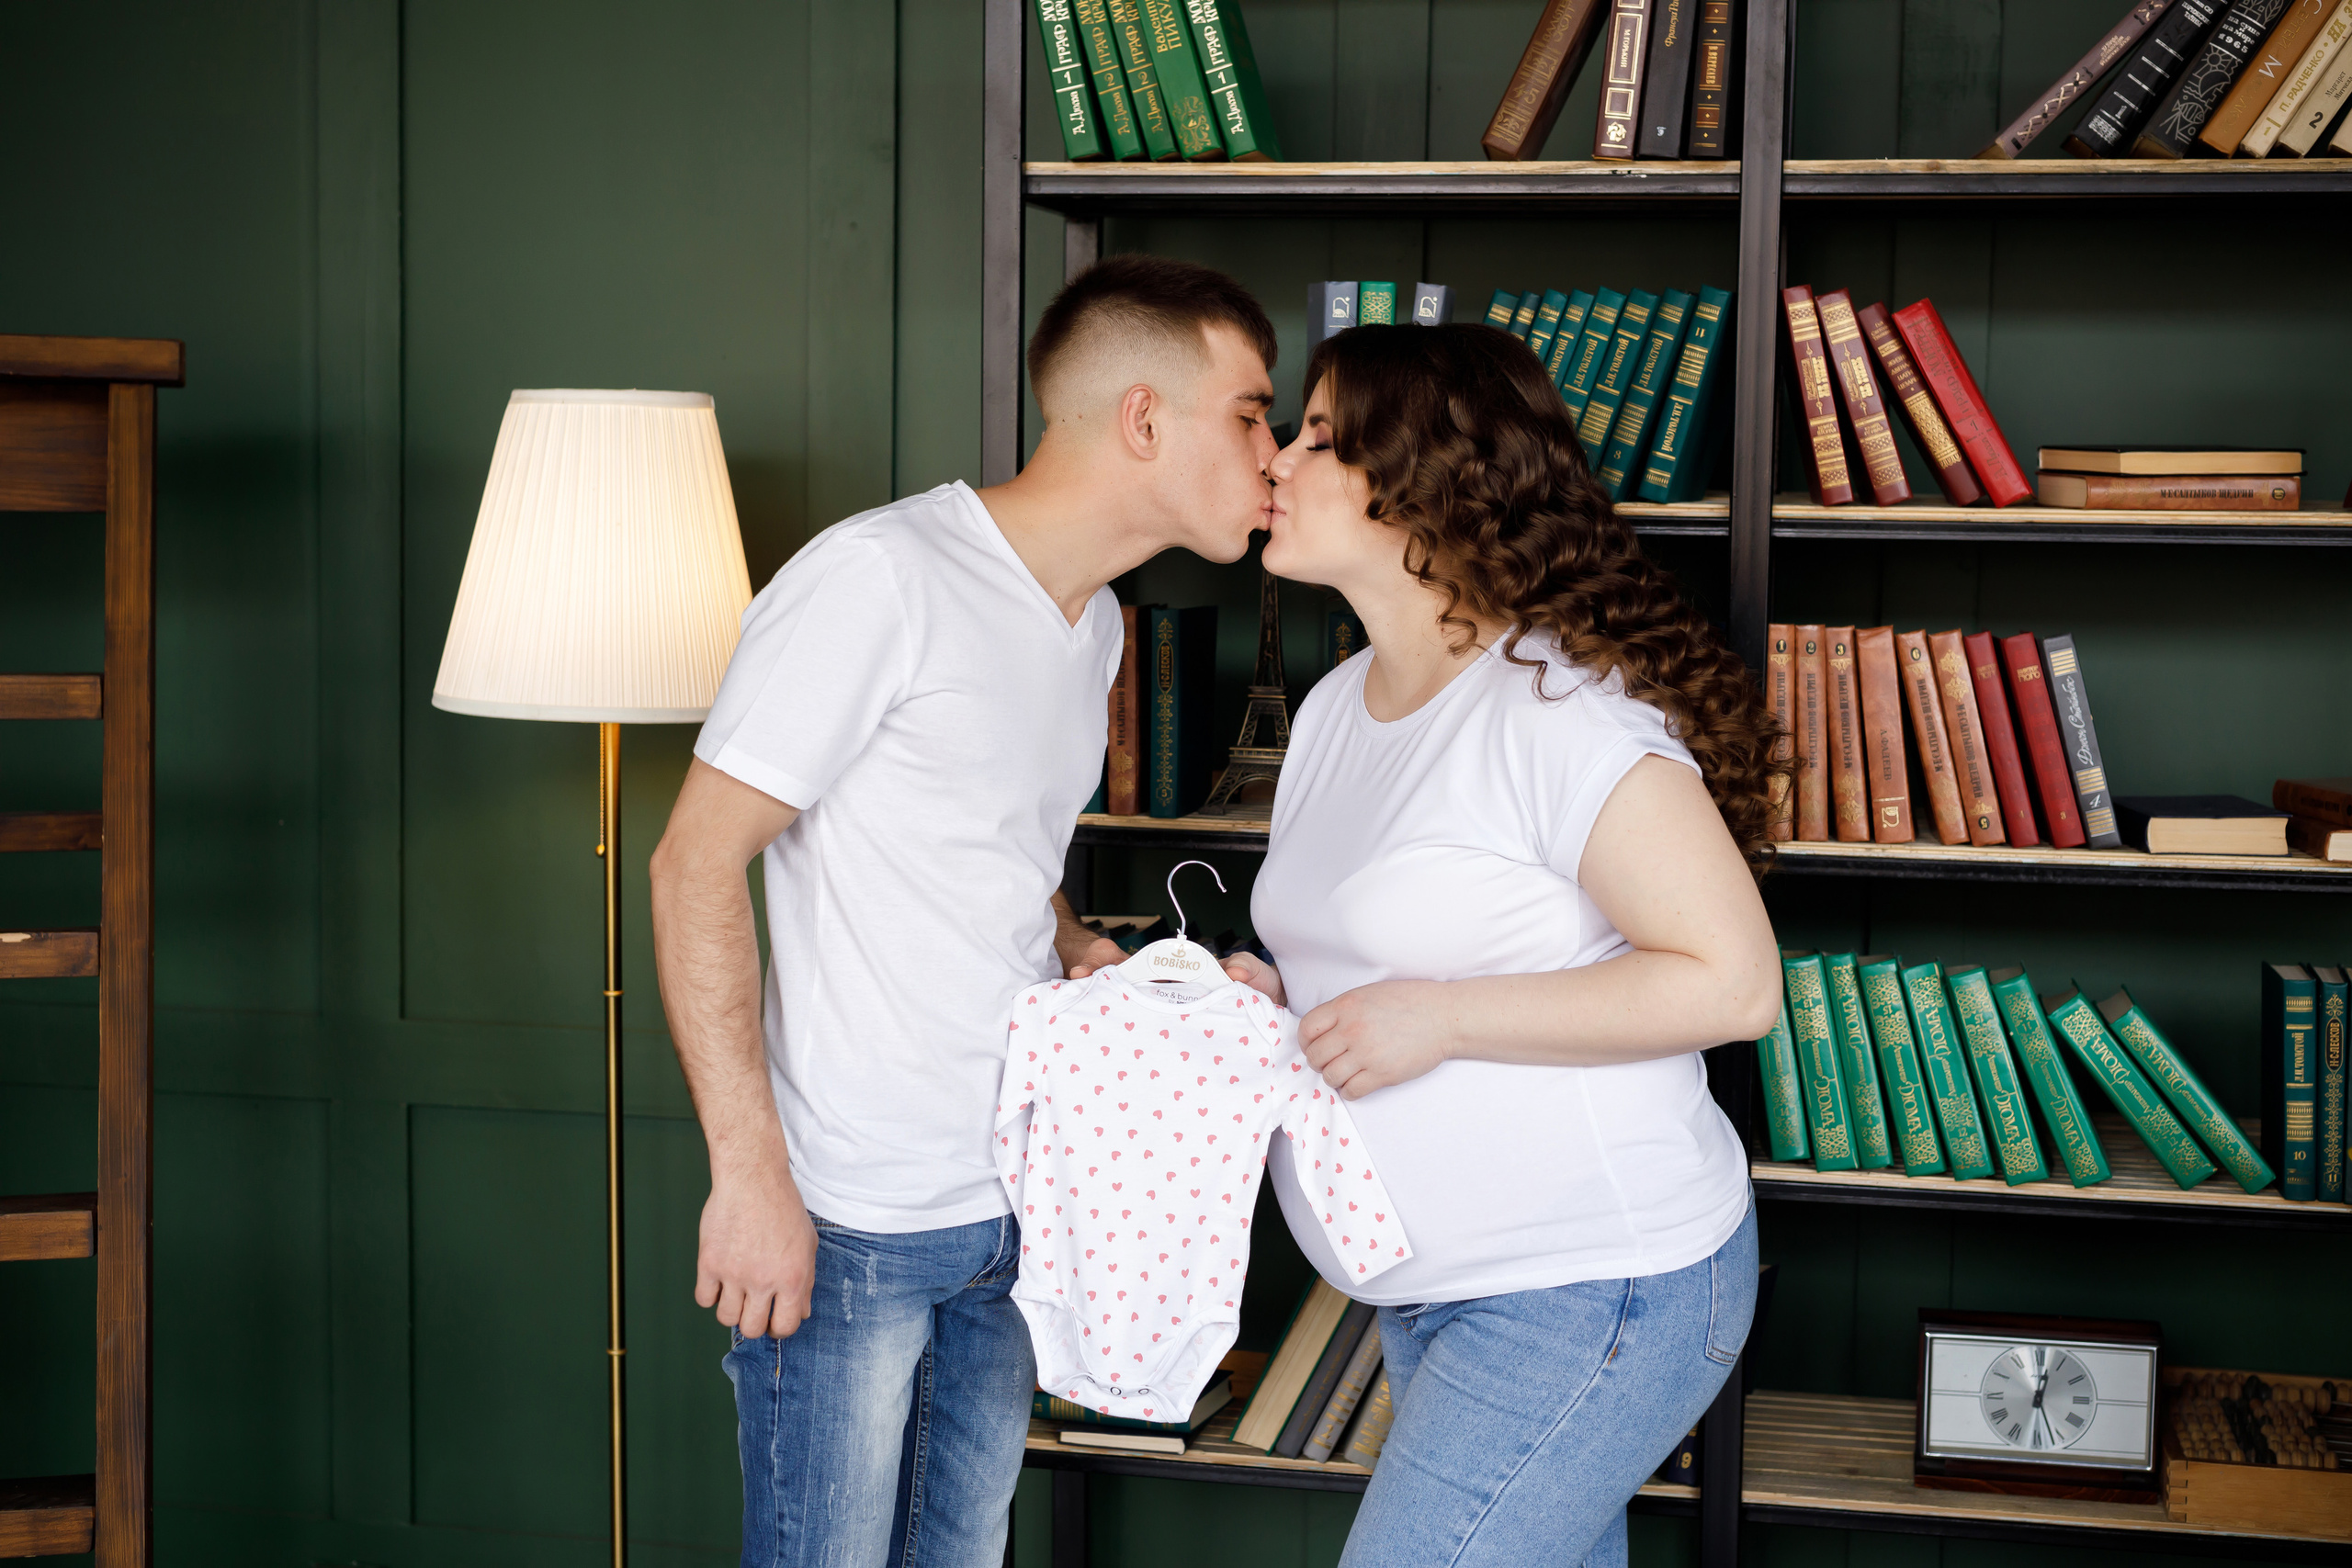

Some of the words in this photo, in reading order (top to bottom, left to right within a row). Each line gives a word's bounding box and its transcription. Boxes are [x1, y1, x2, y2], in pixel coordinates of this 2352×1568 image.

[1664, 11, 1679, 47] Франсуа
[2222, 24, 2234, 33] на
[2227, 16, 2239, 25] на
[2240, 21, 2261, 37] суше
[1054, 24, 1072, 64] ГРАФ
[1092, 27, 1112, 66] ГРАФ
[1125, 25, 1146, 65] ГРАФ
[1204, 26, 1226, 65] ГРАФ
[1064, 71, 1072, 84] 1
[1104, 73, 1115, 86] 2
[1137, 72, 1148, 85] 2
[1218, 72, 1227, 85] 1
[2278, 102, 2291, 112] П.
[2287, 50, 2324, 101] РАДЧЕНКО
[2325, 71, 2346, 98] Маргарет
[2309, 111, 2324, 130] 2
[1613, 450, 1622, 460] 8
[1779, 640, 1784, 651] 1
[1808, 642, 1815, 653] 2
[1838, 644, 1844, 656] 3
[1912, 649, 1919, 660] 6
[2089, 794, 2101, 808] 4
[1156, 989, 1169, 998] fox
[1842, 998, 1865, 1049] ДЮМА
[1926, 1008, 1951, 1060] ДЮМА
[2090, 1037, 2132, 1084] ДЮМА
[2148, 1045, 2188, 1093] ДЮМА
[1814, 1075, 1836, 1128] ДЮМА
[1897, 1081, 1922, 1134] ДЮМА
[1993, 1090, 2020, 1144] ДЮМА
[2050, 1095, 2080, 1146] ДЮМА
[2294, 1151, 2307, 1161] 10
[2328, 1174, 2338, 1183] 11
[1321, 1424, 1333, 1439] 2
